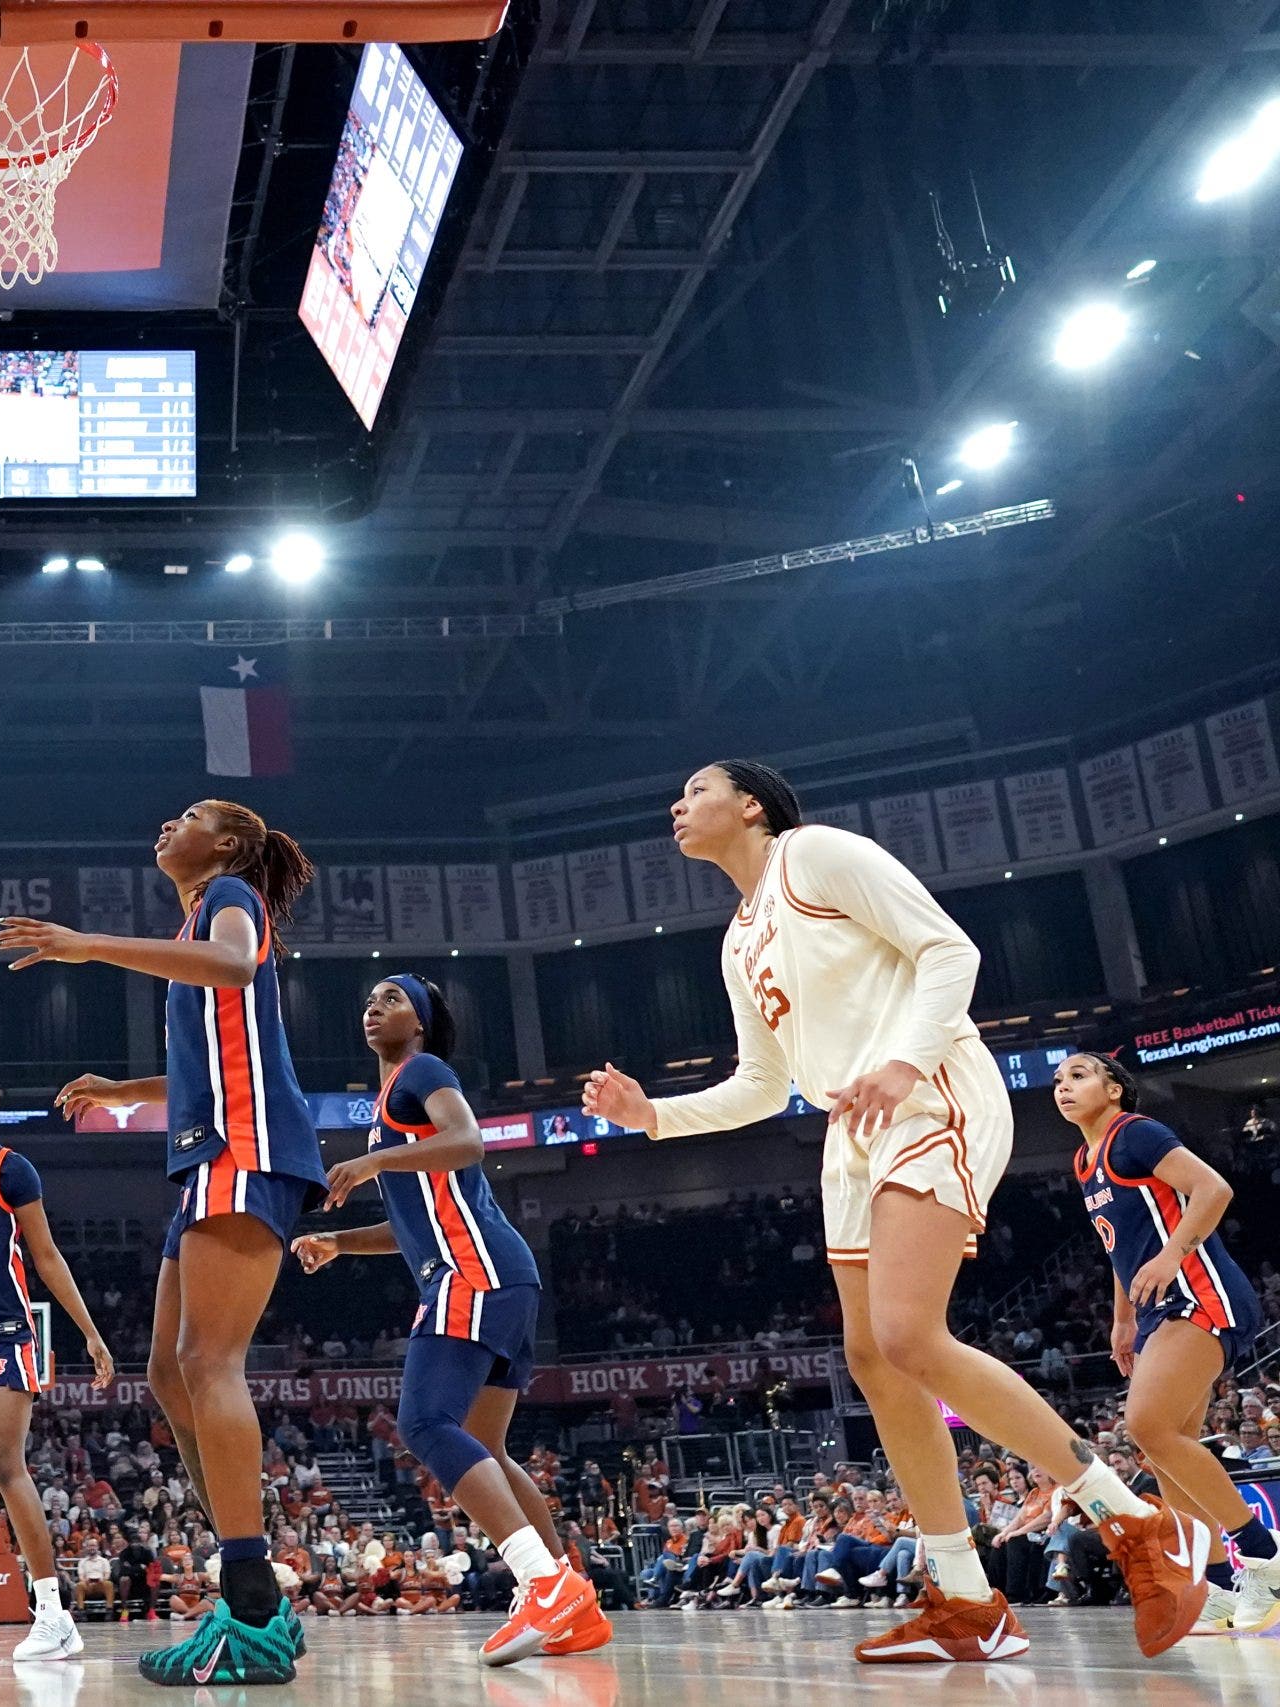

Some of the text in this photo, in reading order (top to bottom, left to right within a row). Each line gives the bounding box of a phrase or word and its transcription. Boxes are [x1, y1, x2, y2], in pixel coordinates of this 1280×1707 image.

[1134, 1029, 1170, 1048] FREE
[1172, 1011, 1245, 1040] Basketball
[1136, 1021, 1280, 1064] TexasLonghorns.com
[1008, 1054, 1021, 1069] FT
[797, 1099, 805, 1114] 2
[194, 1130, 202, 1139] 44
[1092, 1214, 1116, 1254] 0
[245, 1377, 311, 1401] EXAS
[320, 1376, 404, 1400] LONGH
